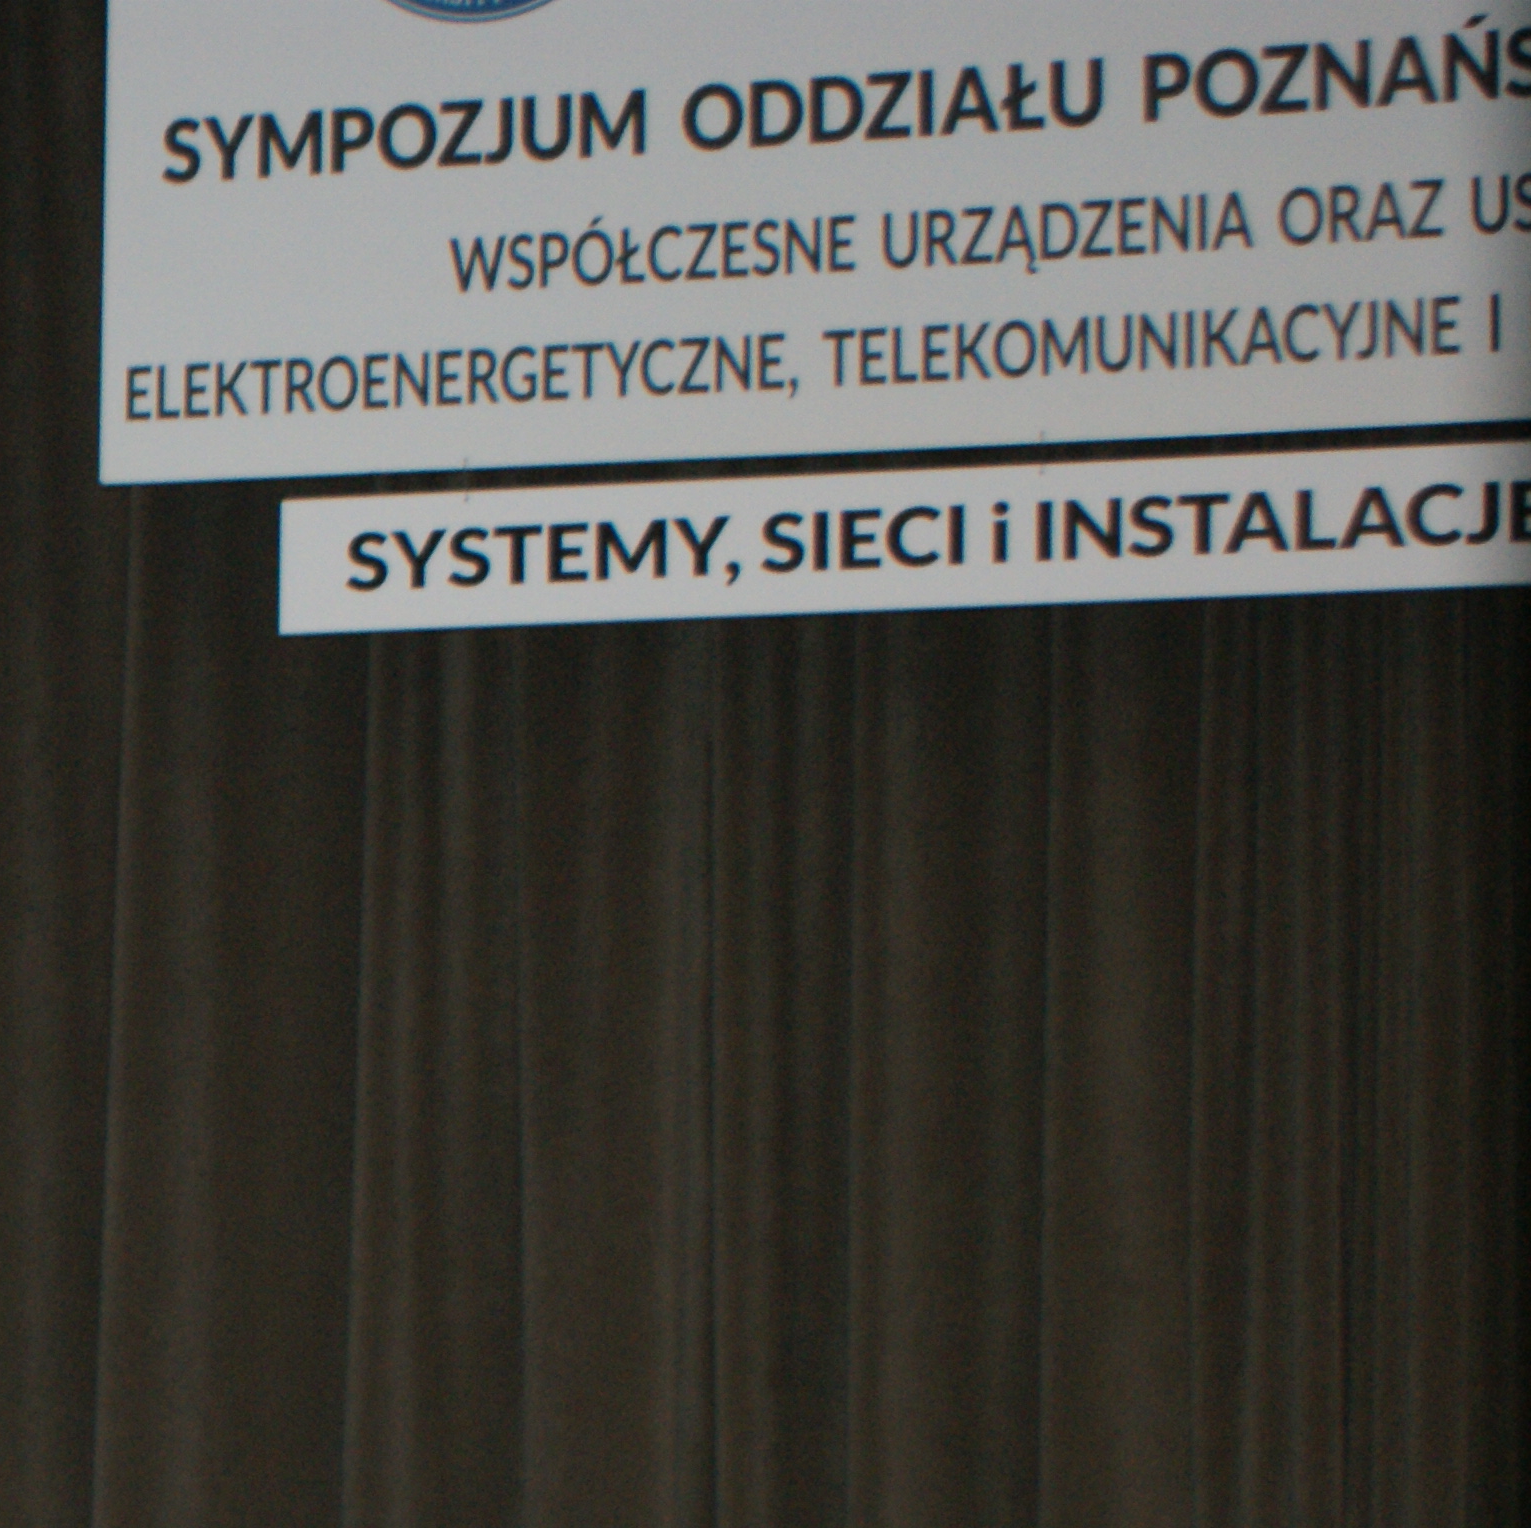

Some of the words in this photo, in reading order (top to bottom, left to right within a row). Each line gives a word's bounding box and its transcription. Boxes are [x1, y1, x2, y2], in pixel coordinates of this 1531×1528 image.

[161, 88, 647, 184] SYMPOZJUM
[682, 57, 1104, 150] ODDZIAŁU
[1143, 14, 1531, 122] POZNAŃS
[449, 215, 857, 292] WSPÓŁCZESNE
[882, 191, 1254, 274] URZĄDZENIA
[1277, 178, 1445, 246] ORAZ
[125, 331, 800, 422] ELEKTROENERGETYCZNE,
[823, 295, 1462, 388] TELEKOMUNIKACYJNE
[1488, 292, 1501, 353] I
[346, 514, 740, 591] SYSTEMY,
[762, 504, 967, 573] SIECI
[992, 501, 1010, 564] i
